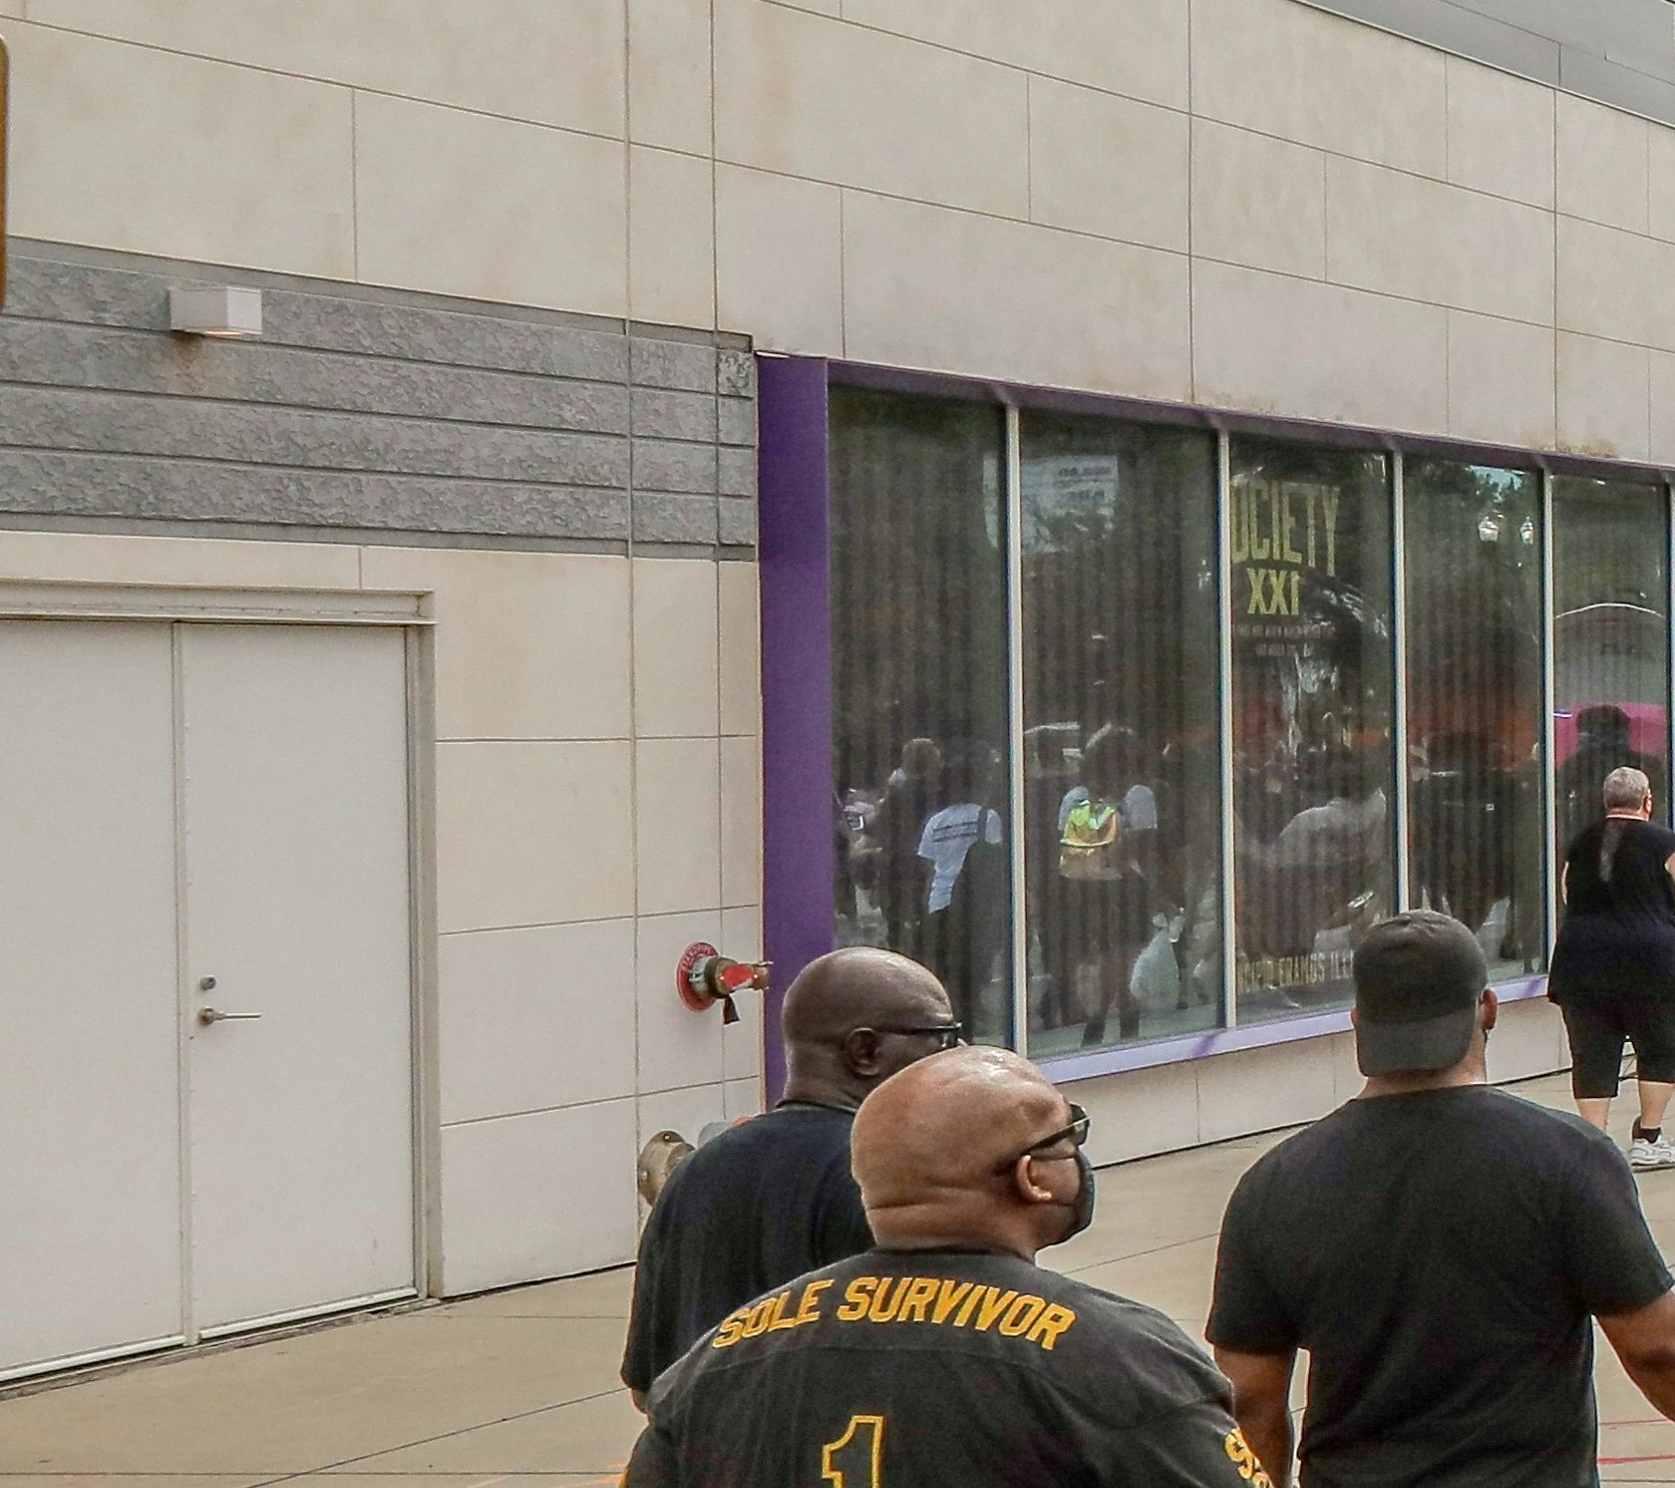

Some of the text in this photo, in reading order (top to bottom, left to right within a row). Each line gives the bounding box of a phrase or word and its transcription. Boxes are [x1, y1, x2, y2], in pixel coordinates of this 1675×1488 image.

[1231, 480, 1341, 578] OCIETY
[1246, 567, 1301, 615] XXI
[711, 1274, 1078, 1351] SOLE SURVIVOR
